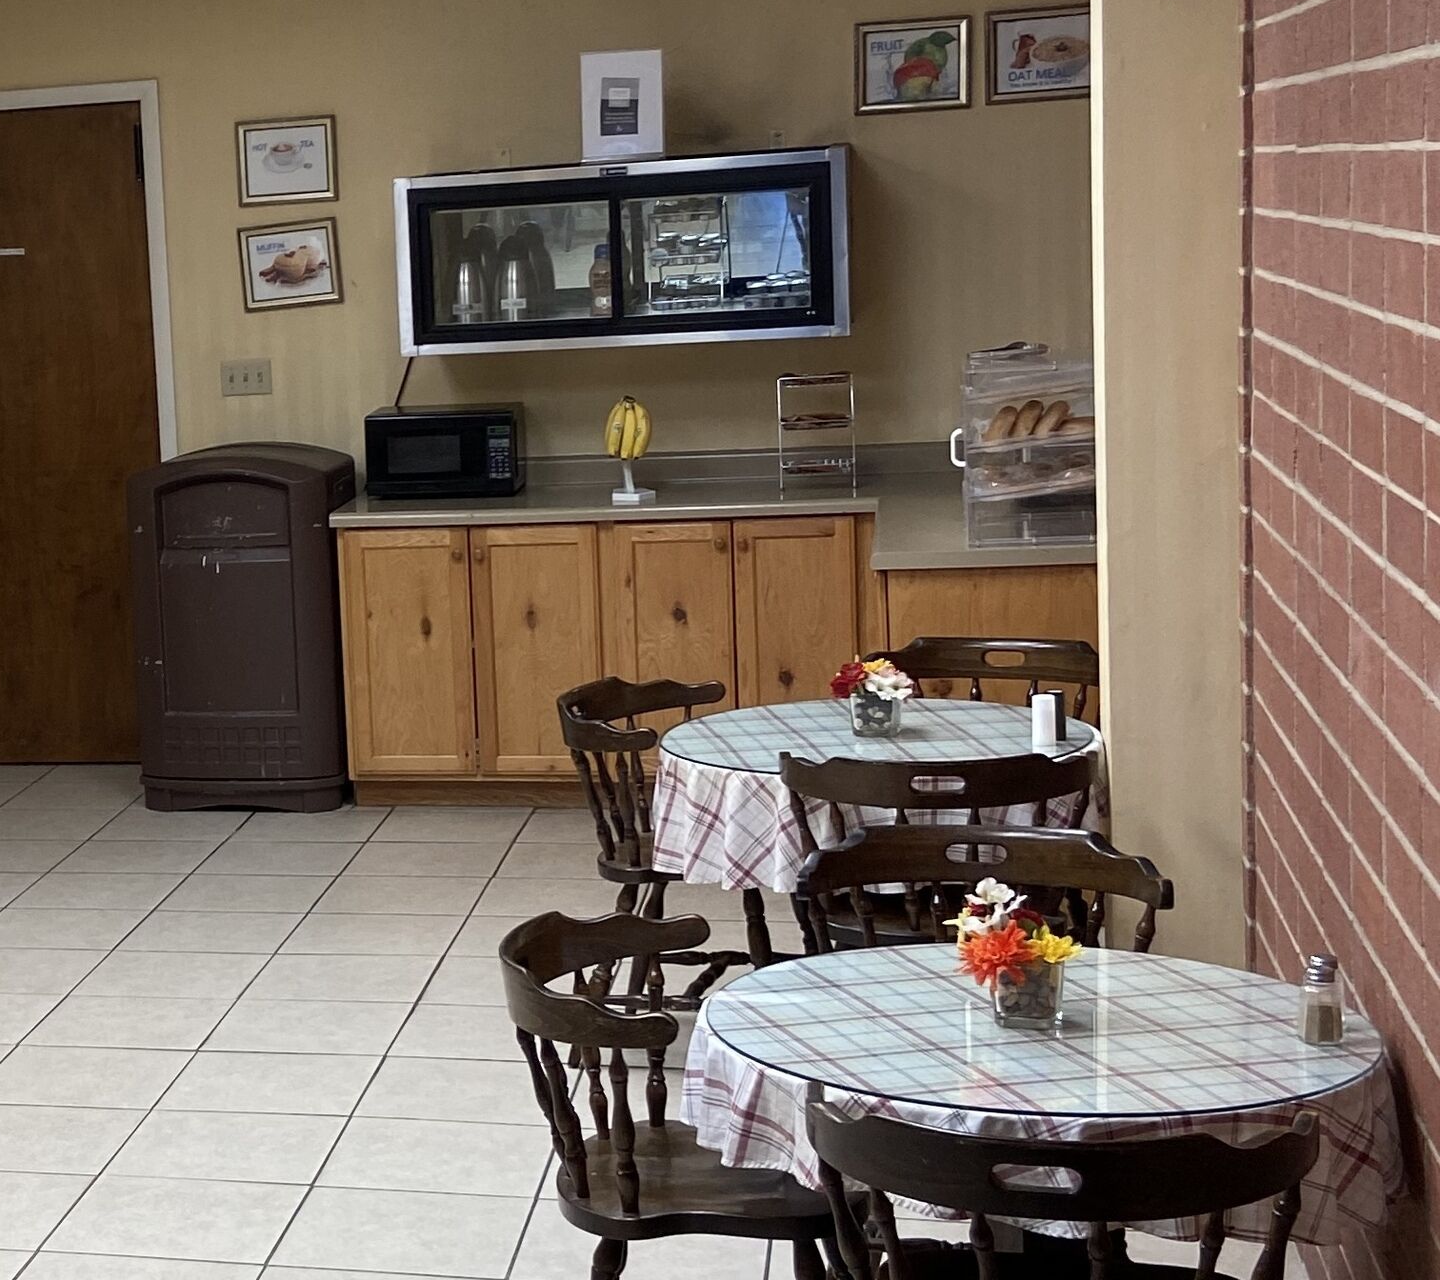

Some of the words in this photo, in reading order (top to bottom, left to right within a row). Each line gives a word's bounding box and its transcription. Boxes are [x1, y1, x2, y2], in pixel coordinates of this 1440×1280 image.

[870, 38, 905, 52] FRUIT
[1008, 70, 1033, 82] OAT
[1035, 67, 1071, 80] MEAL
[252, 143, 268, 152] HOT
[300, 139, 314, 150] TEA
